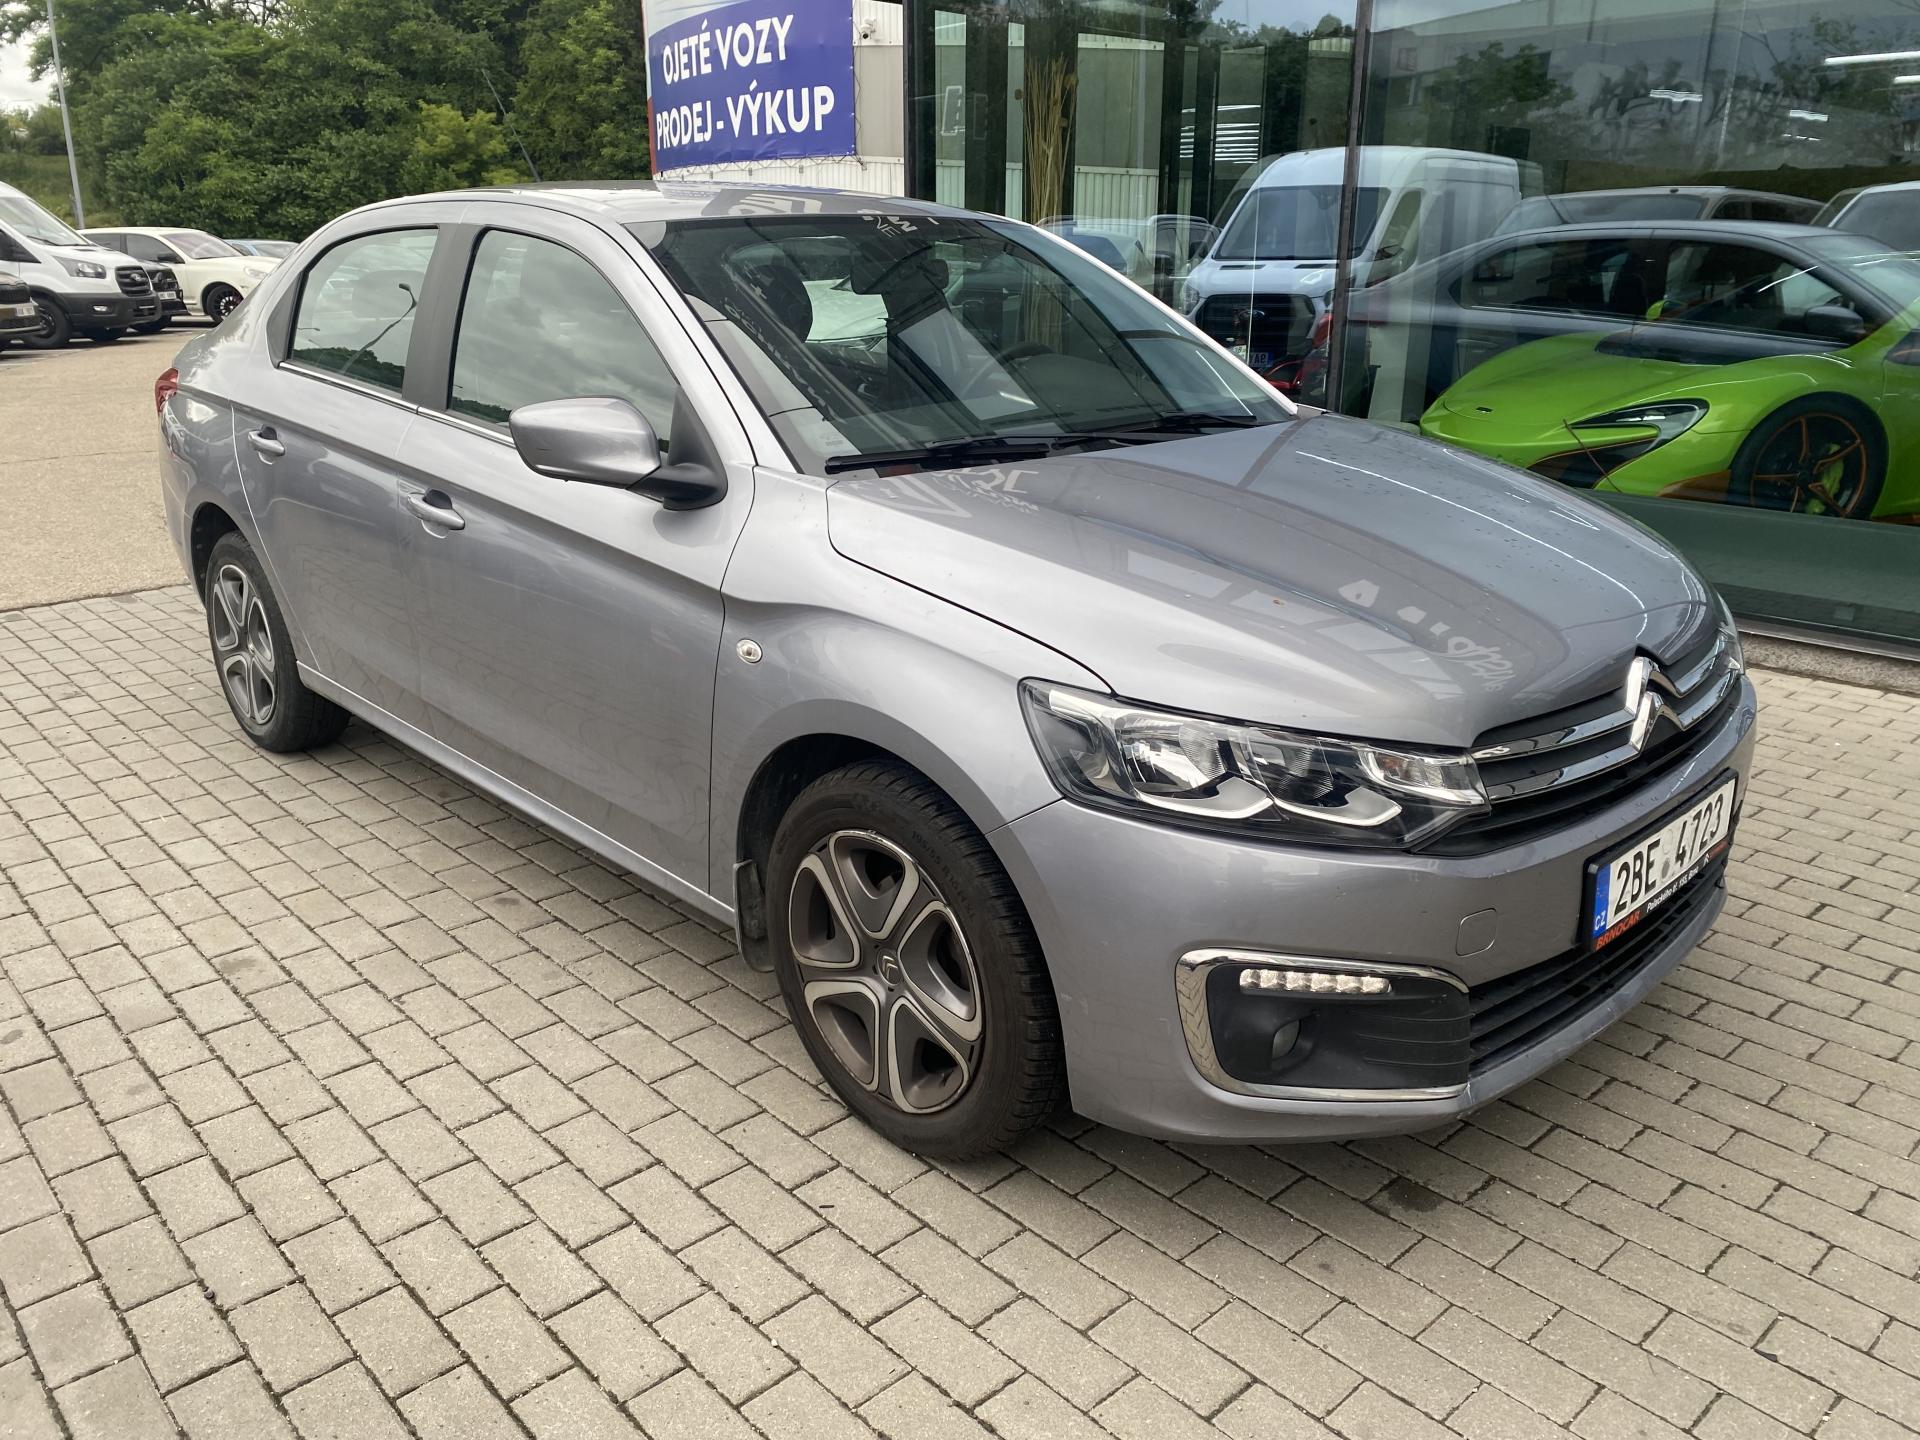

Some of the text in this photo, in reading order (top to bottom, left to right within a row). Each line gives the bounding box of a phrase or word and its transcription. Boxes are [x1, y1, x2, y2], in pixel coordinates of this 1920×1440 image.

[662, 14, 794, 85] OJETÉ VOZY
[1613, 793, 1724, 918] 2BE 4723
[1594, 910, 1606, 931] CZ
[1595, 910, 1641, 950] BRNOCAR
